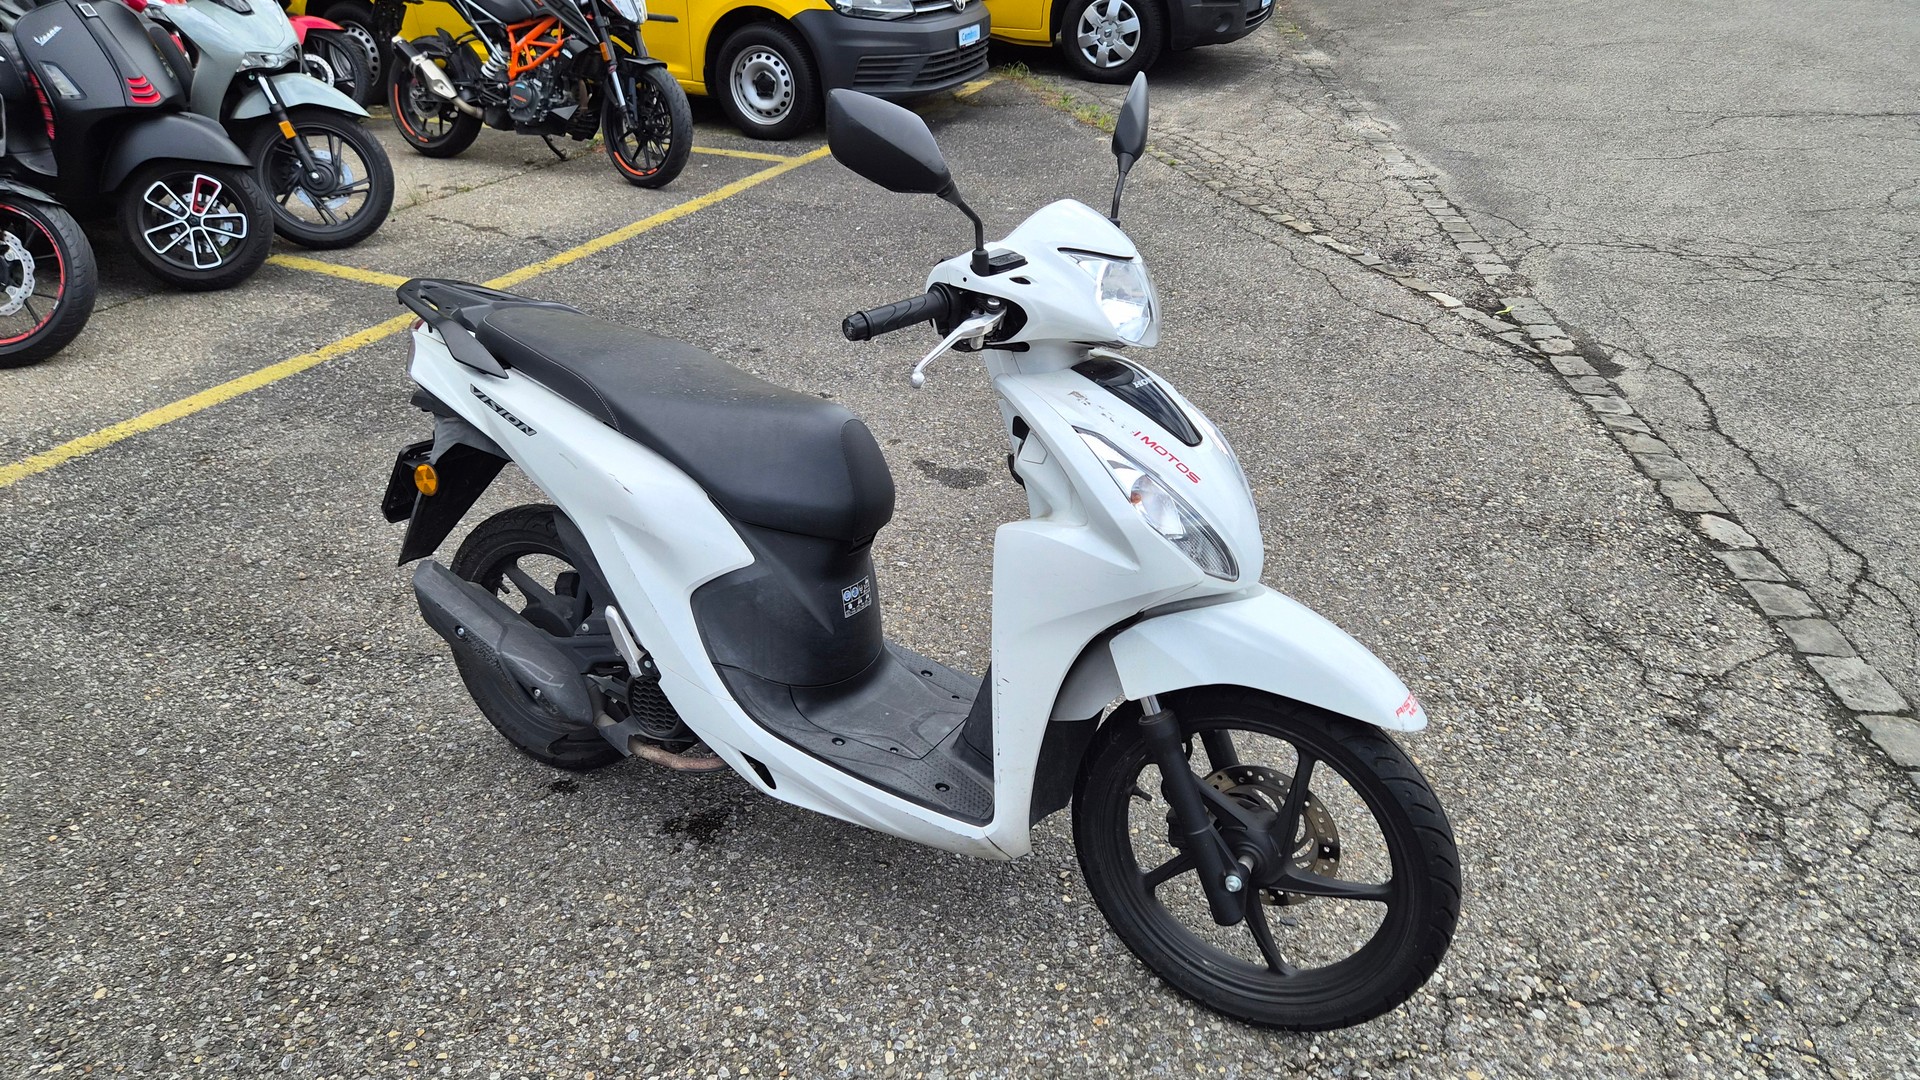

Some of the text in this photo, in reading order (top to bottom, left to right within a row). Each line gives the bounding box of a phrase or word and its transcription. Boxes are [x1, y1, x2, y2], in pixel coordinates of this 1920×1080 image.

[33, 25, 62, 46] Vespa
[469, 383, 538, 437] VISION
[1140, 435, 1202, 484] MOTOS
